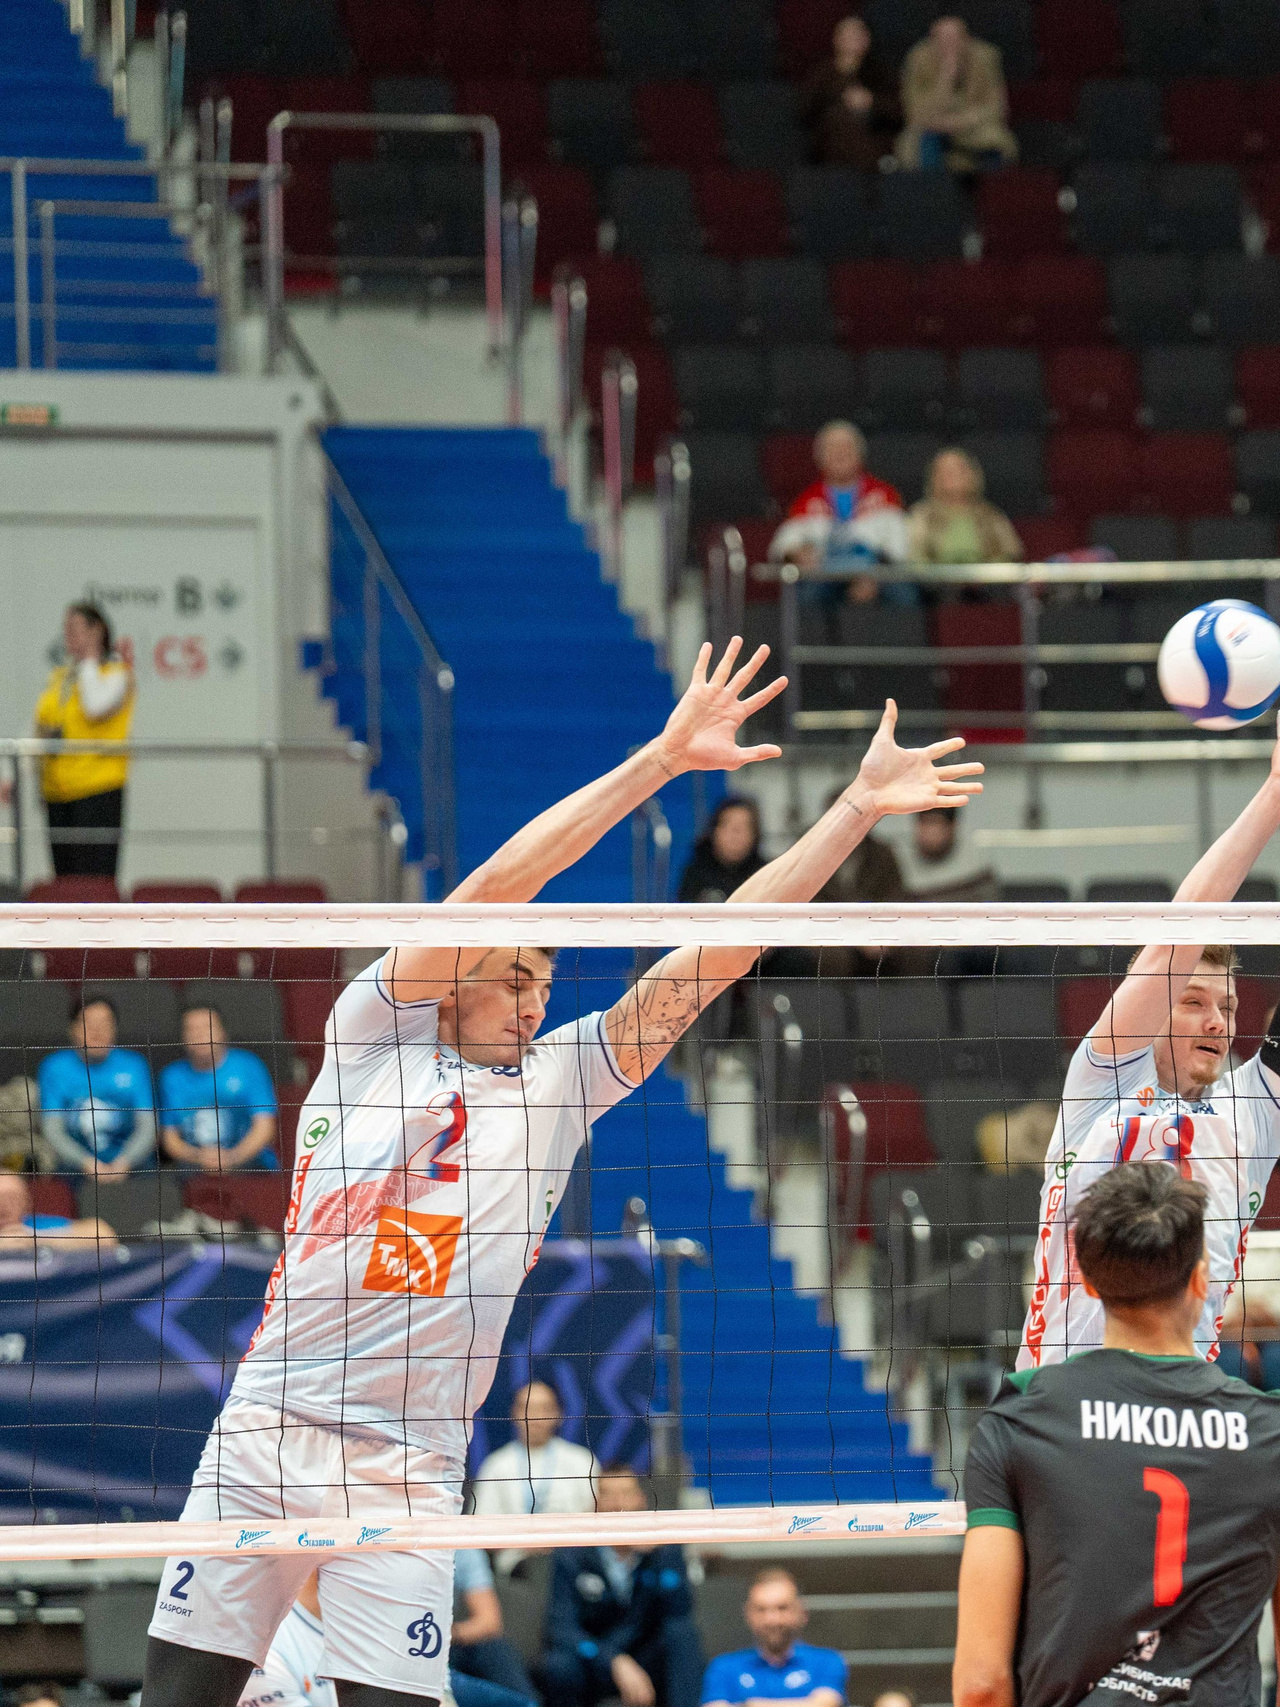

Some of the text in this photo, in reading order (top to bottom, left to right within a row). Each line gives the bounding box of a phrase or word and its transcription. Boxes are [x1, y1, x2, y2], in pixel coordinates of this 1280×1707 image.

[406, 1090, 468, 1183] 2
[1080, 1399, 1250, 1451] НИКОЛОВ
[1143, 1466, 1190, 1607] 1
[170, 1560, 194, 1600] 2
[159, 1601, 193, 1617] ZASPORT
[1097, 1677, 1158, 1702] ОБЛАСТЬ
